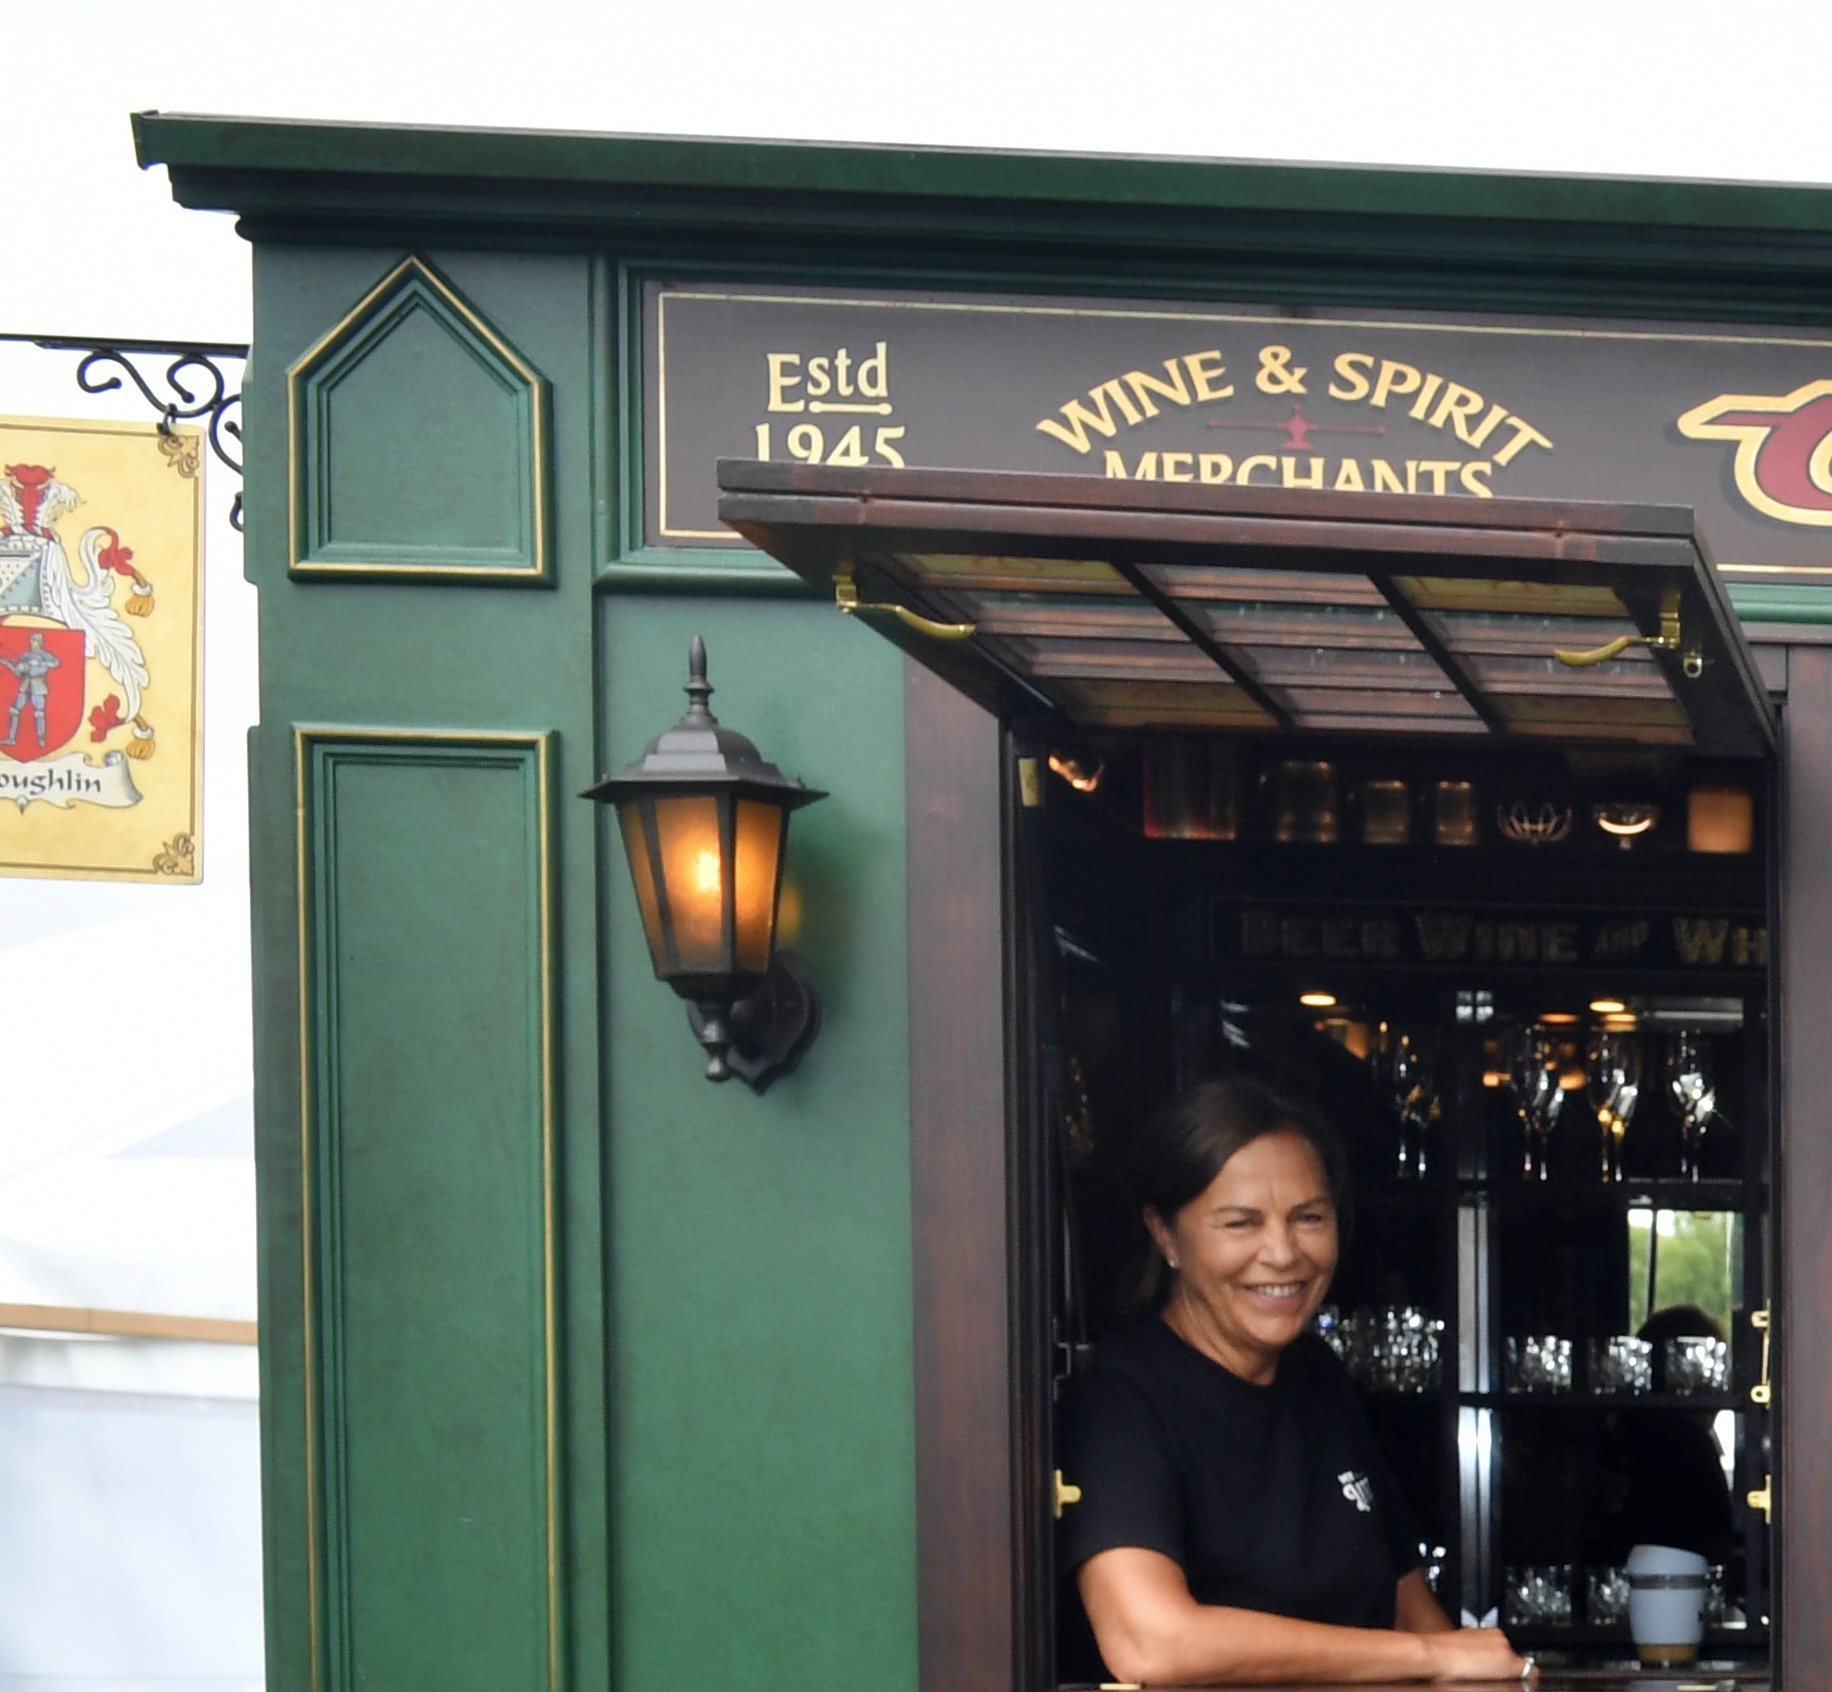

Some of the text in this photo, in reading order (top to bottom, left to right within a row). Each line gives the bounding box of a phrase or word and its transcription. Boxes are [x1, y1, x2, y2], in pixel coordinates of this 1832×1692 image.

[766, 341, 889, 413] Estd
[1036, 344, 1554, 467] WINE & SPIRIT
[755, 422, 906, 470] 1945
